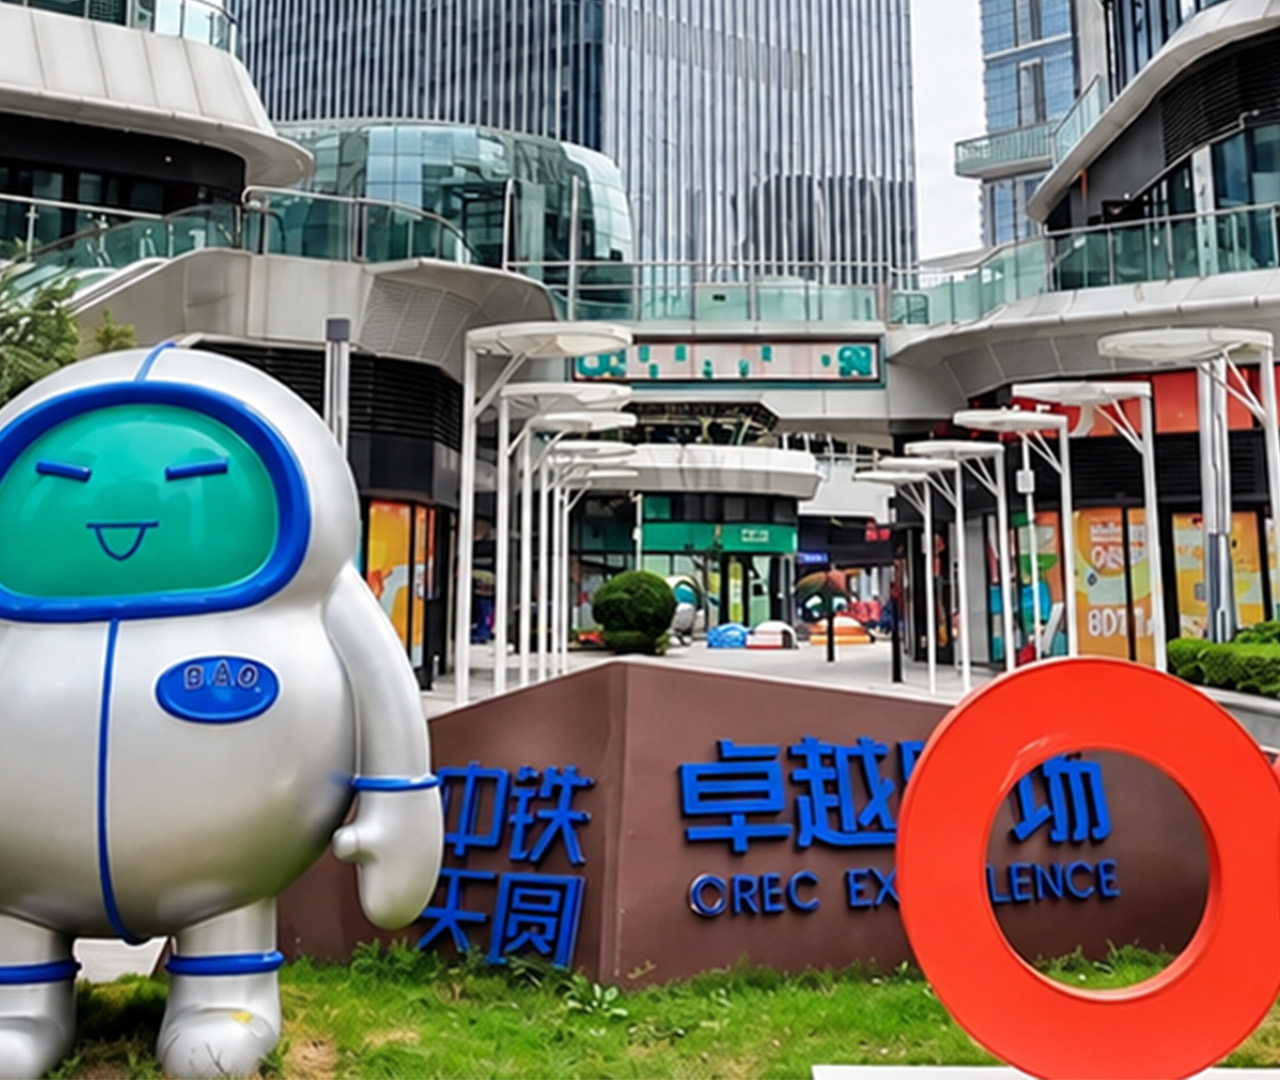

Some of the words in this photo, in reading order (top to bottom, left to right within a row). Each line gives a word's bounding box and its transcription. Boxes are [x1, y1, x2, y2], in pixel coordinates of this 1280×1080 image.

[437, 761, 594, 864] 中铁
[679, 736, 1113, 850] 卓越场
[846, 856, 1122, 907] EXLENCE
